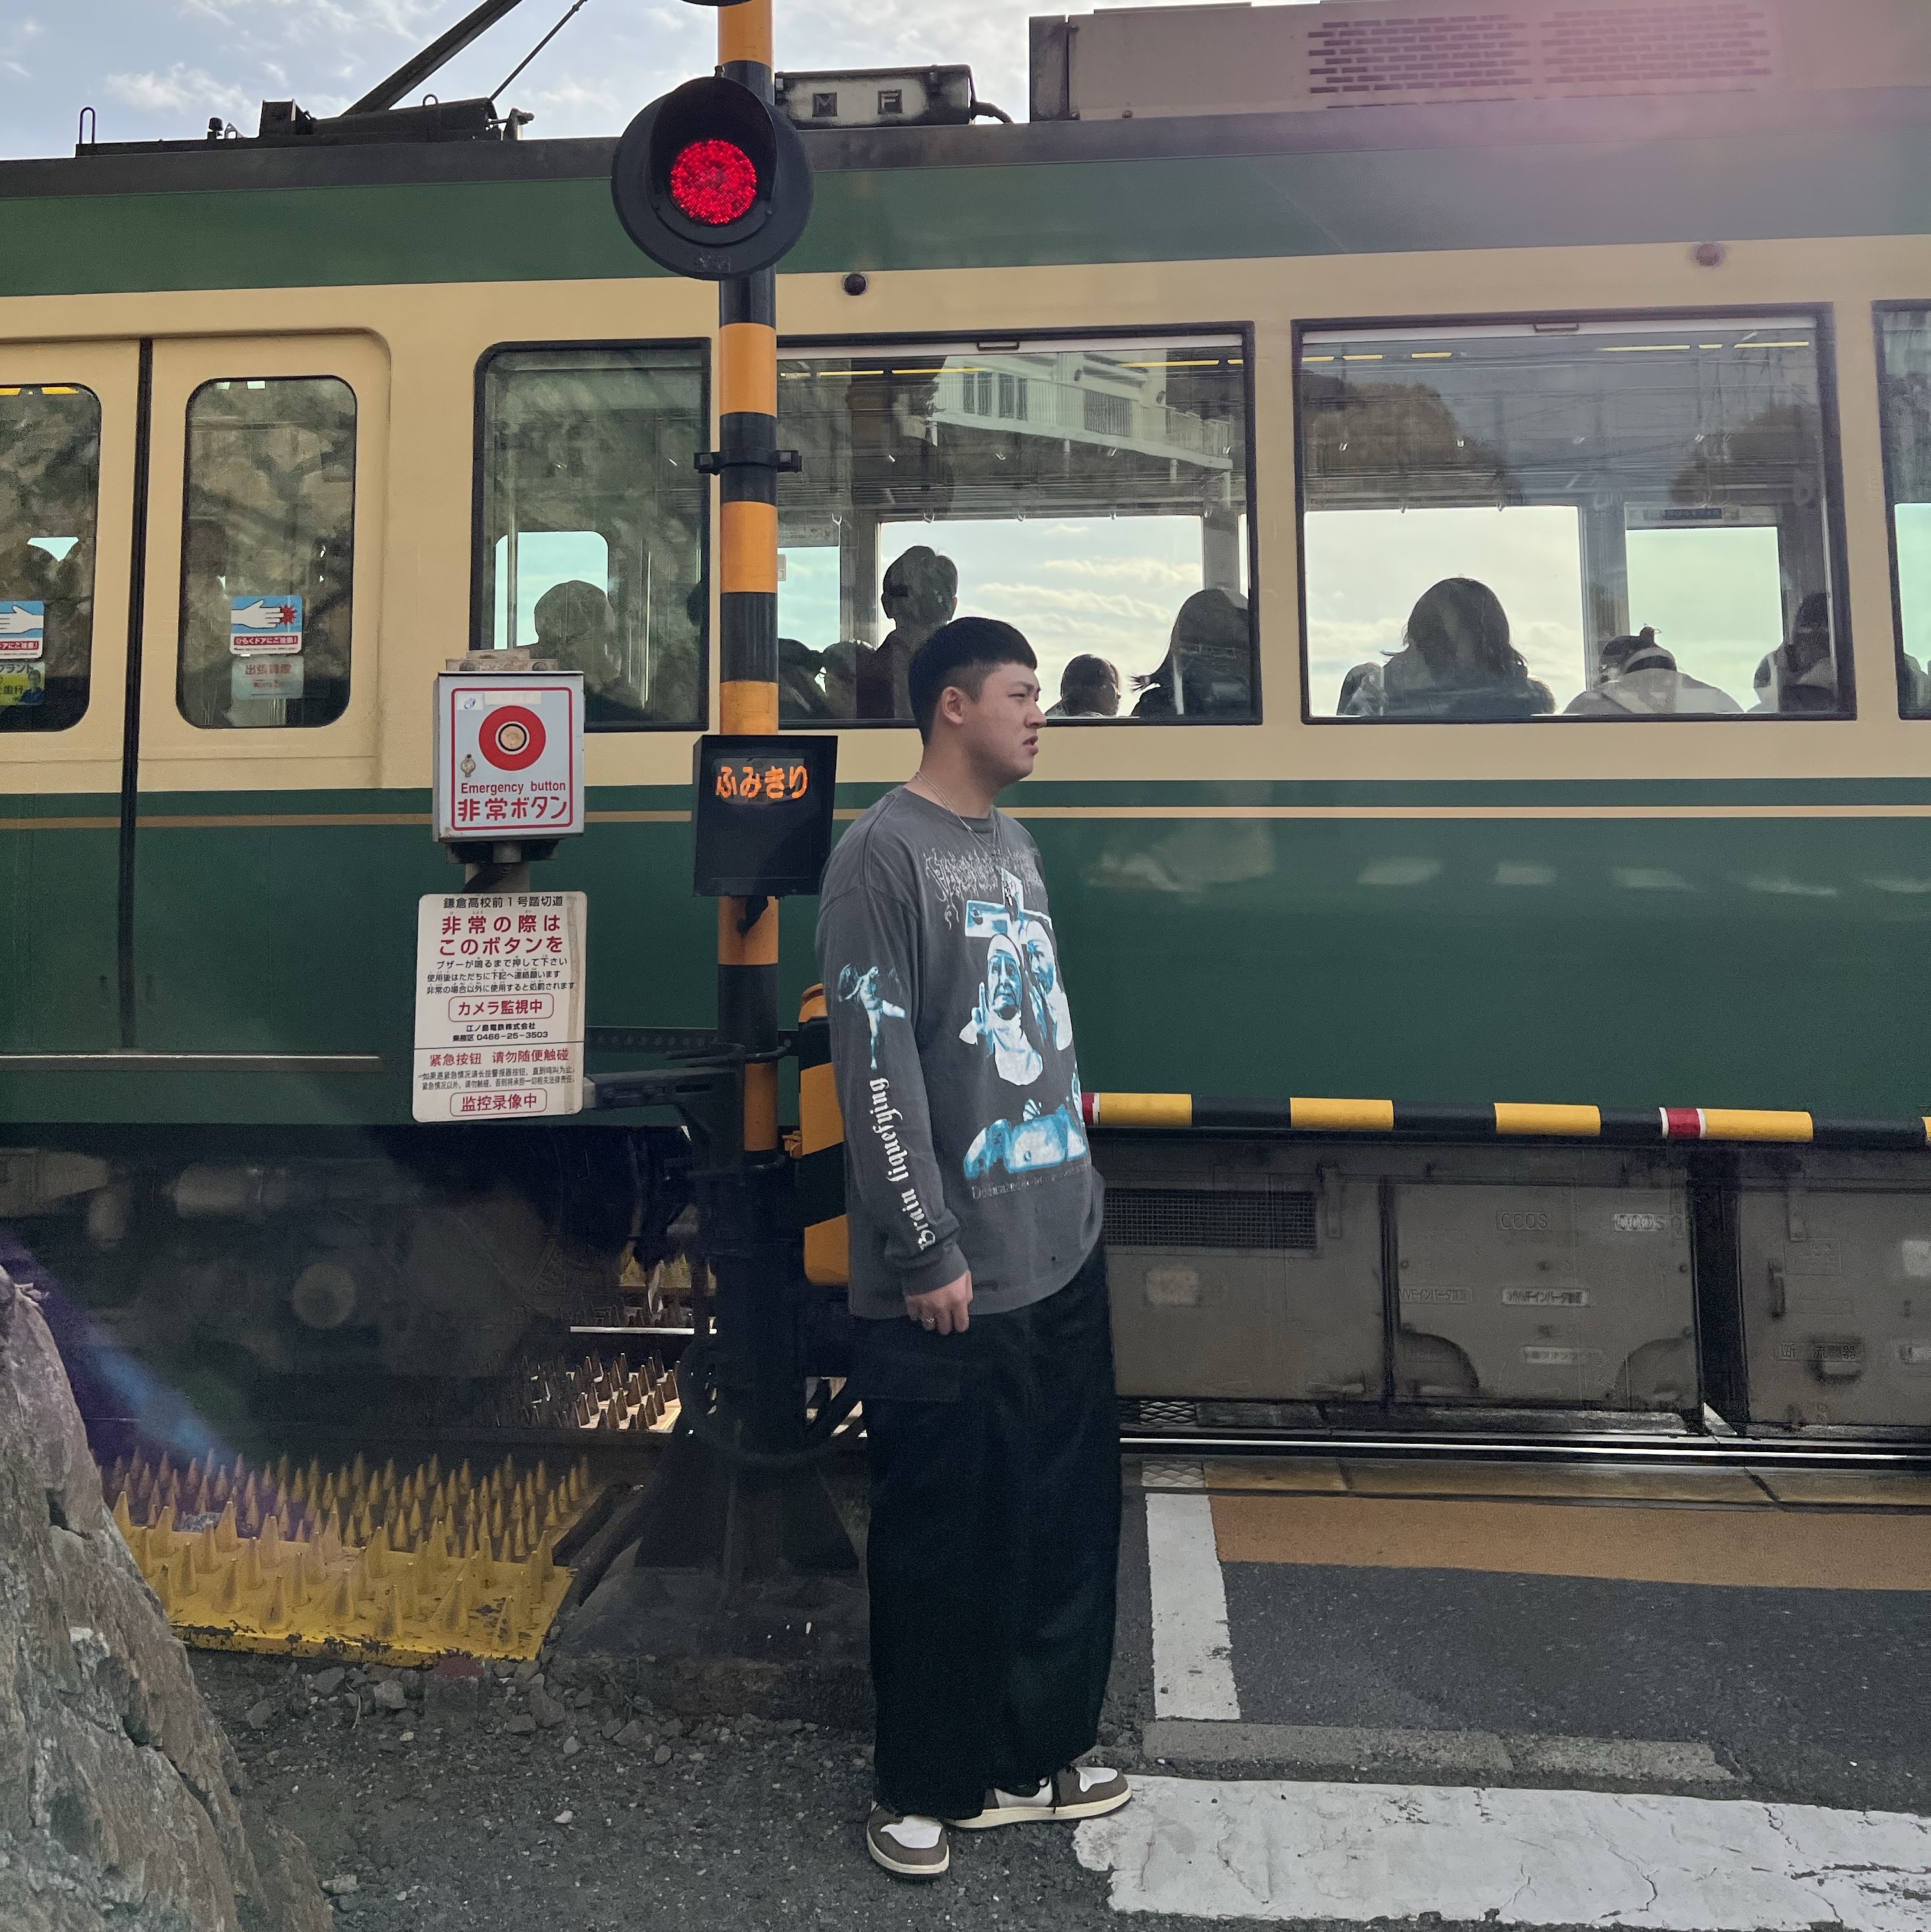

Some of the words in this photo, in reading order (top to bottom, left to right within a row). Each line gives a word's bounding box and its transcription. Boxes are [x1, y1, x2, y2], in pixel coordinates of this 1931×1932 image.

[461, 783, 524, 795] Emergency
[531, 781, 566, 792] button
[715, 765, 808, 799] ふみきり
[458, 796, 567, 822] 非常ボタン
[443, 896, 563, 908] 鎌倉高校前1号踏切道
[442, 914, 561, 935] 非常の際は
[439, 935, 563, 956] このボタンを
[436, 958, 567, 969] ブザーが鳴るまで押して下さい
[458, 999, 542, 1016] カメラ監視中
[466, 1022, 536, 1032] 江ノ島電鉄株式会社
[430, 1052, 482, 1066] 紧急按钮
[492, 1048, 569, 1064] 请勿随便触碰
[461, 1092, 537, 1112] 监控录像中
[869, 1078, 910, 1182] liquefying
[901, 1188, 936, 1250] Brain
[1500, 1213, 1548, 1229] CCOS
